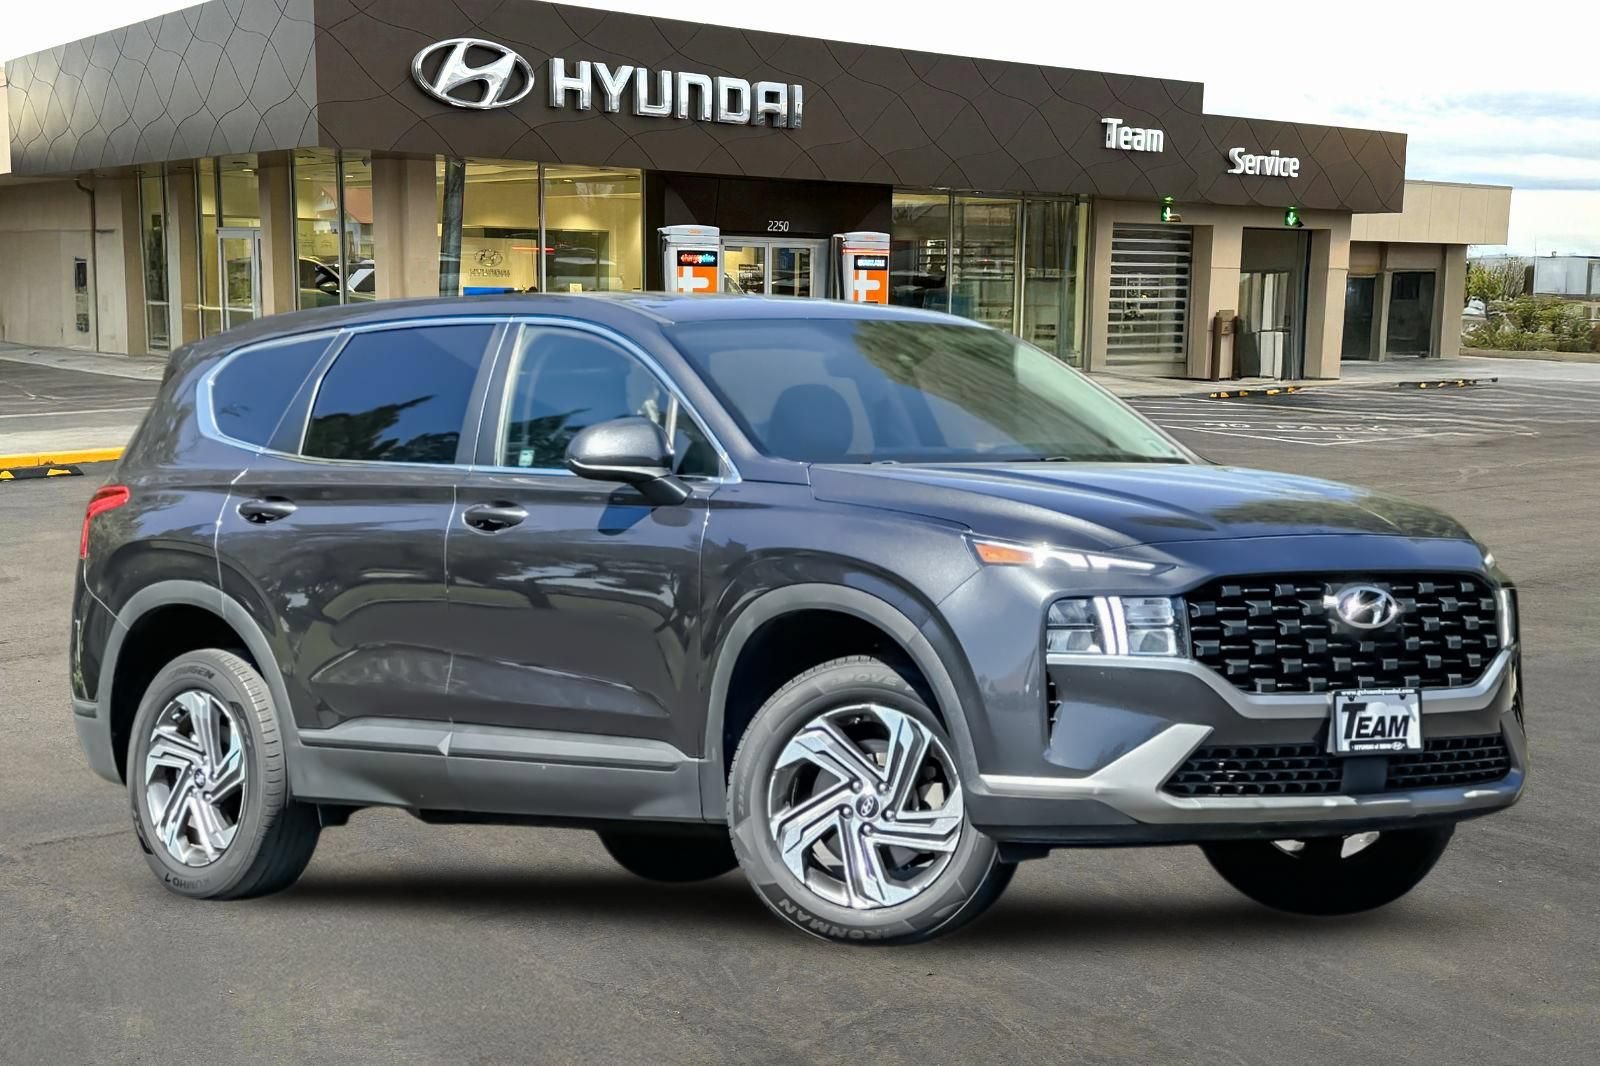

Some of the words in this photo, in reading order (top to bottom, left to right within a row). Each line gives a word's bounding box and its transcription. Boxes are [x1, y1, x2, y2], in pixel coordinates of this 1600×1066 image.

[548, 57, 803, 129] HYUNDAI
[1101, 117, 1164, 152] Team
[1227, 147, 1300, 178] Service
[767, 220, 790, 232] 2250
[1341, 702, 1410, 740] TEAM
